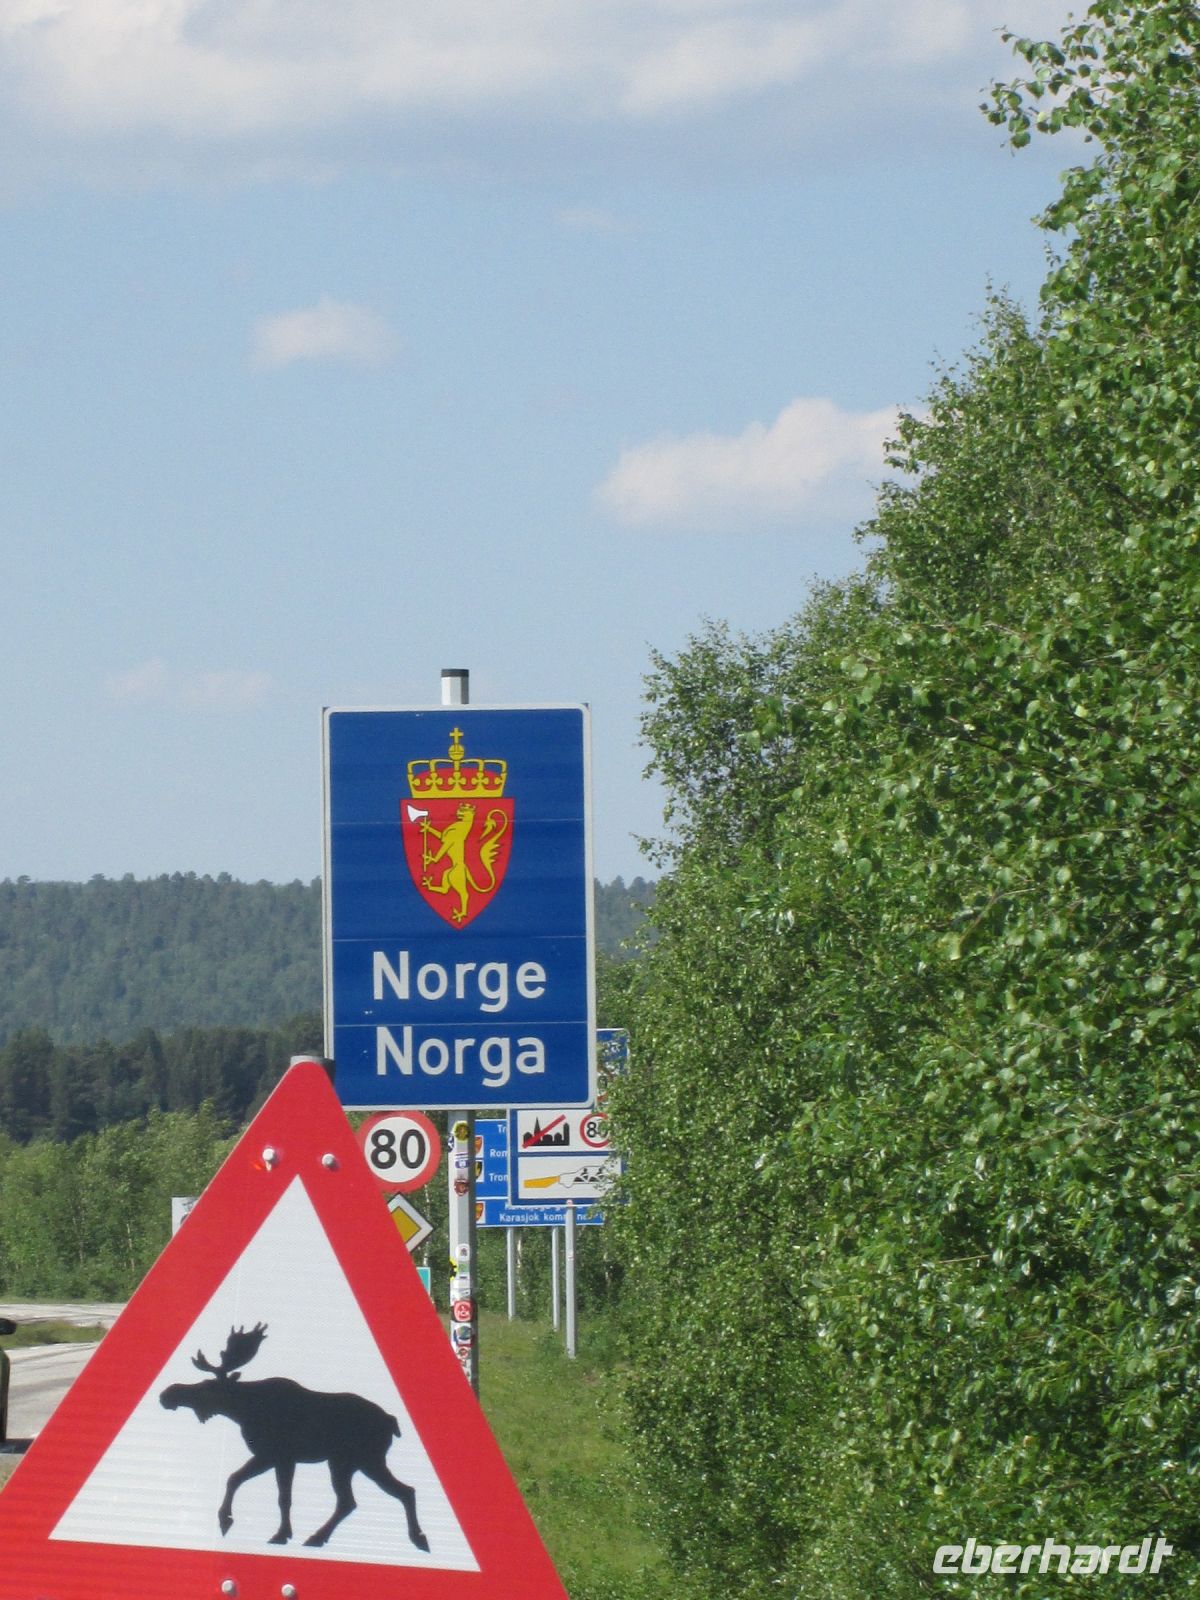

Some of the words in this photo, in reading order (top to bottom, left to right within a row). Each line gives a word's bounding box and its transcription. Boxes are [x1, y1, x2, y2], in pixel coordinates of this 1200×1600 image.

[373, 950, 547, 1013] Norge
[376, 1025, 546, 1088] Norga
[370, 1128, 426, 1170] 80
[499, 1212, 540, 1223] Karasjok
